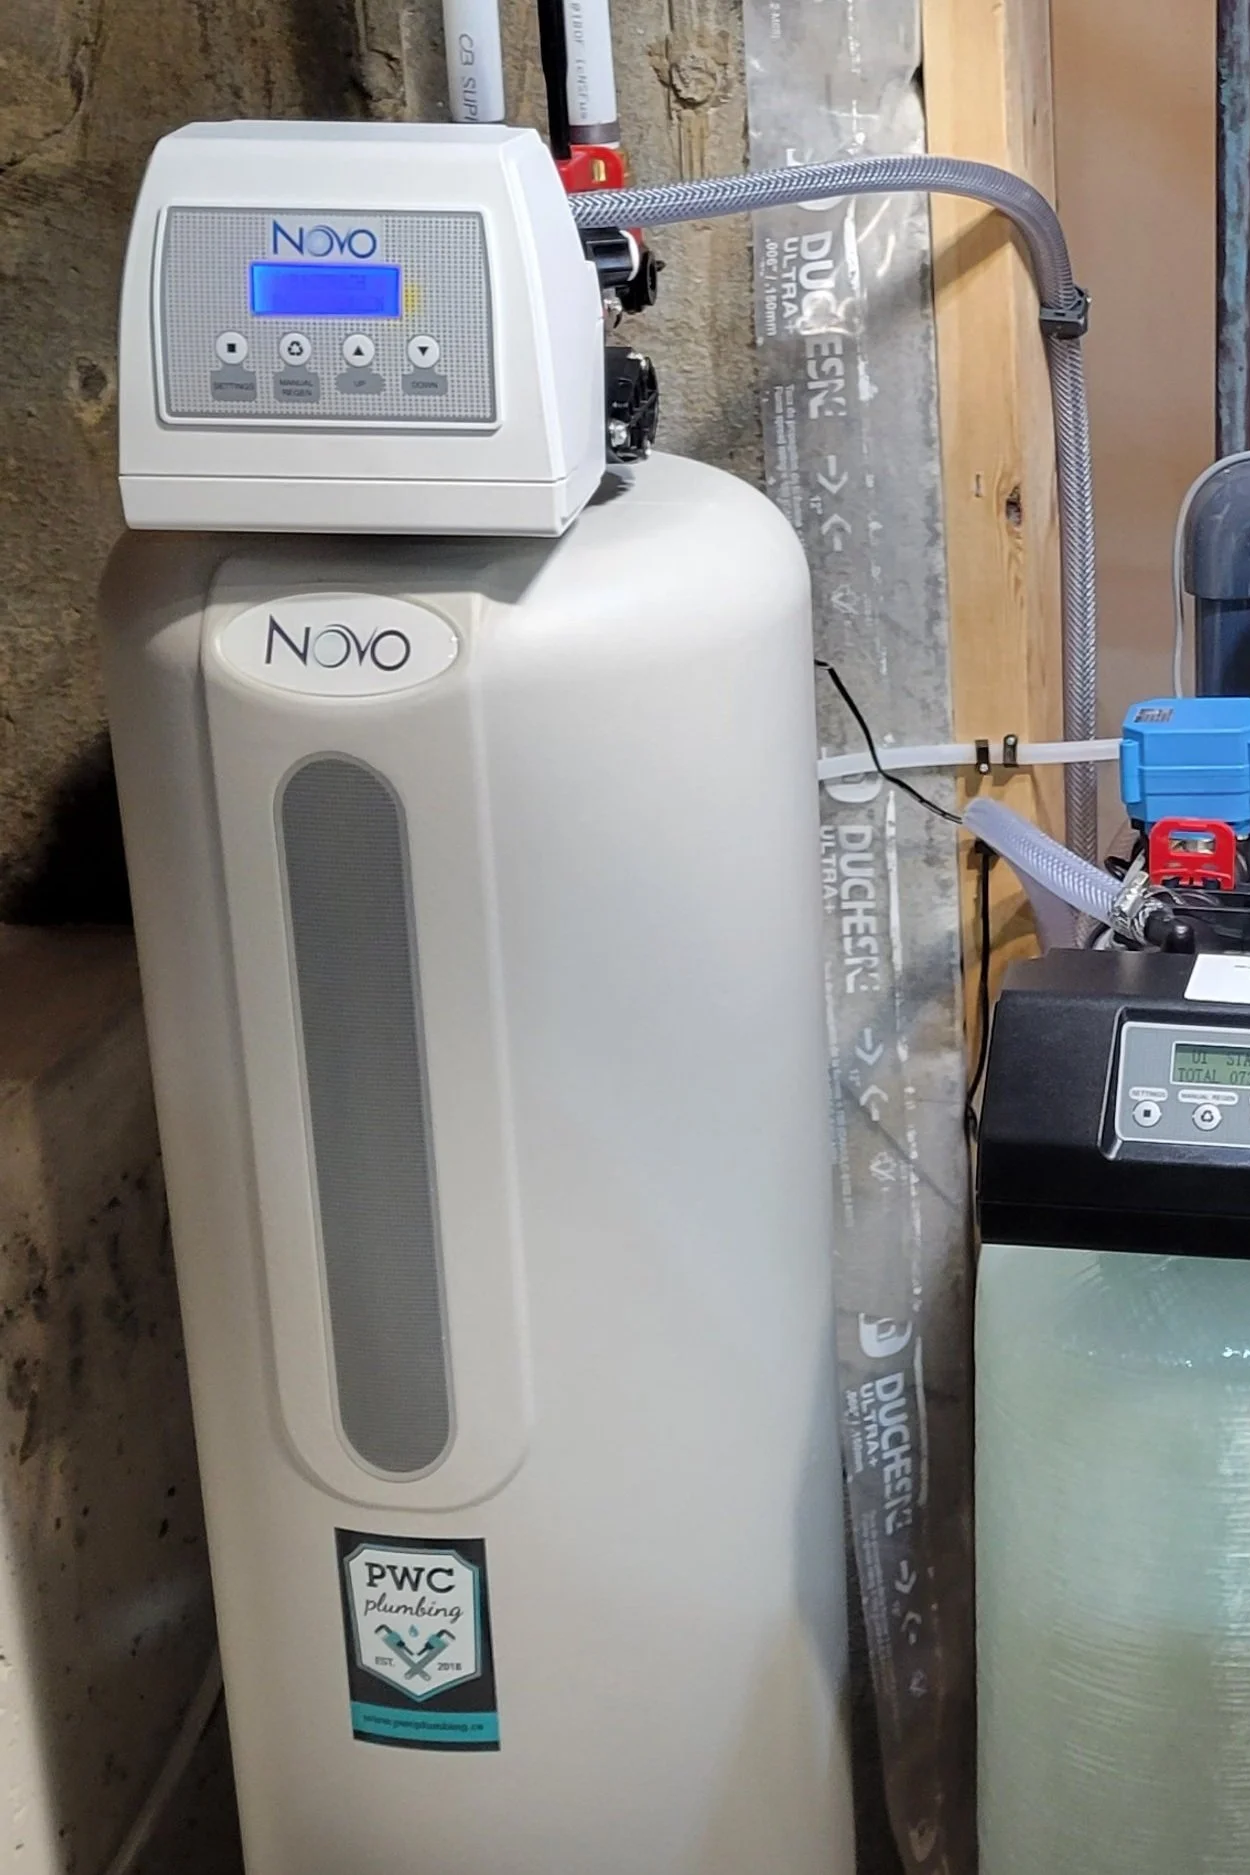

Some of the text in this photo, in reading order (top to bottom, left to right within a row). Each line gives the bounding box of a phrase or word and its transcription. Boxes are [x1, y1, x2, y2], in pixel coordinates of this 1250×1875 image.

[272, 219, 377, 259] NOVO
[264, 614, 411, 672] NOVO
[1178, 1067, 1221, 1084] TOTAL
[364, 1561, 456, 1594] PWC
[363, 1592, 464, 1624] plumbing
